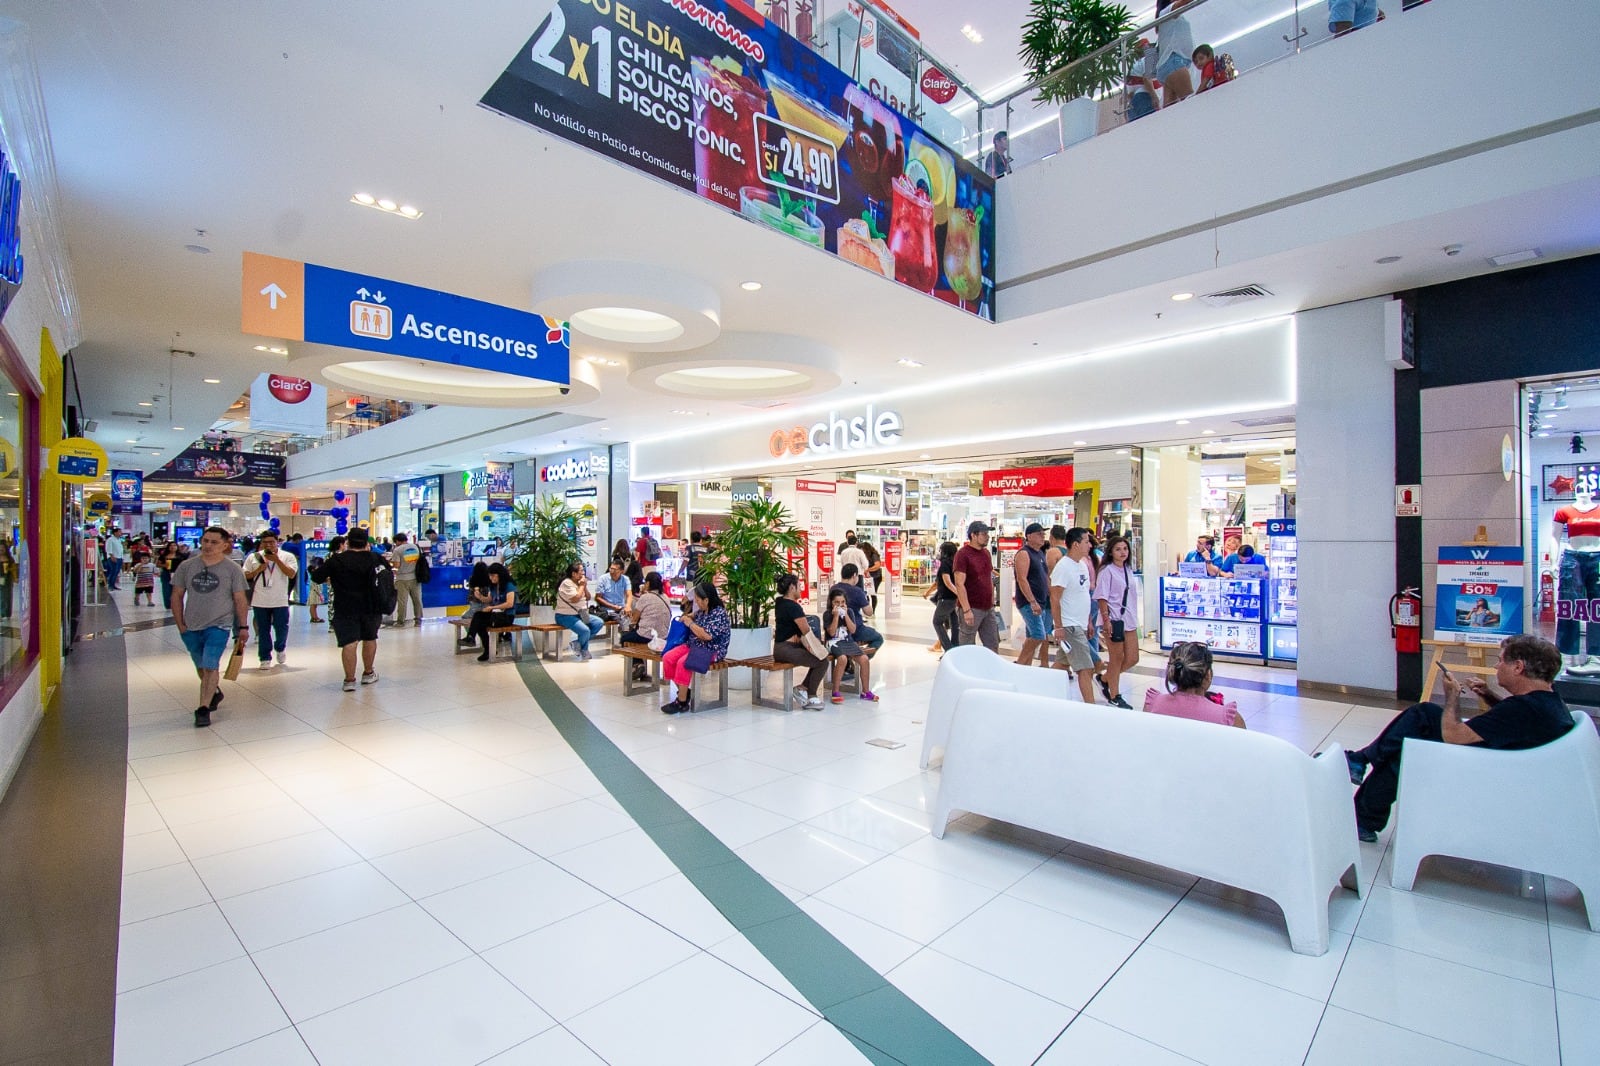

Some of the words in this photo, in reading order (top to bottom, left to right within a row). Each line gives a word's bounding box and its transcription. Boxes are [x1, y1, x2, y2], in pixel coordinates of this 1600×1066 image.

[615, 2, 644, 37] EL
[648, 20, 685, 61] DÍA
[618, 36, 738, 120] CHILCANOS,
[618, 60, 689, 112] SOURS
[693, 99, 706, 120] Y
[923, 78, 950, 89] Claro
[619, 84, 681, 131] PISCO
[684, 118, 746, 165] TONIC.
[761, 141, 780, 153] Desde
[535, 103, 550, 118] No
[552, 112, 585, 134] válido
[588, 129, 600, 141] en
[602, 133, 628, 152] Patio
[629, 143, 640, 158] de
[642, 152, 680, 175] Comidas
[681, 167, 692, 180] de
[693, 174, 710, 190] Mall
[711, 181, 723, 195] del
[724, 188, 738, 201] Sur.
[780, 137, 832, 189] 24.90
[401, 313, 538, 360] Ascensores
[270, 378, 304, 392] Claro
[769, 404, 904, 458] oechsle
[701, 482, 720, 491] HAIR
[858, 489, 879, 498] BEAUTY
[988, 479, 1018, 489] NUEVA
[1019, 478, 1038, 487] APP
